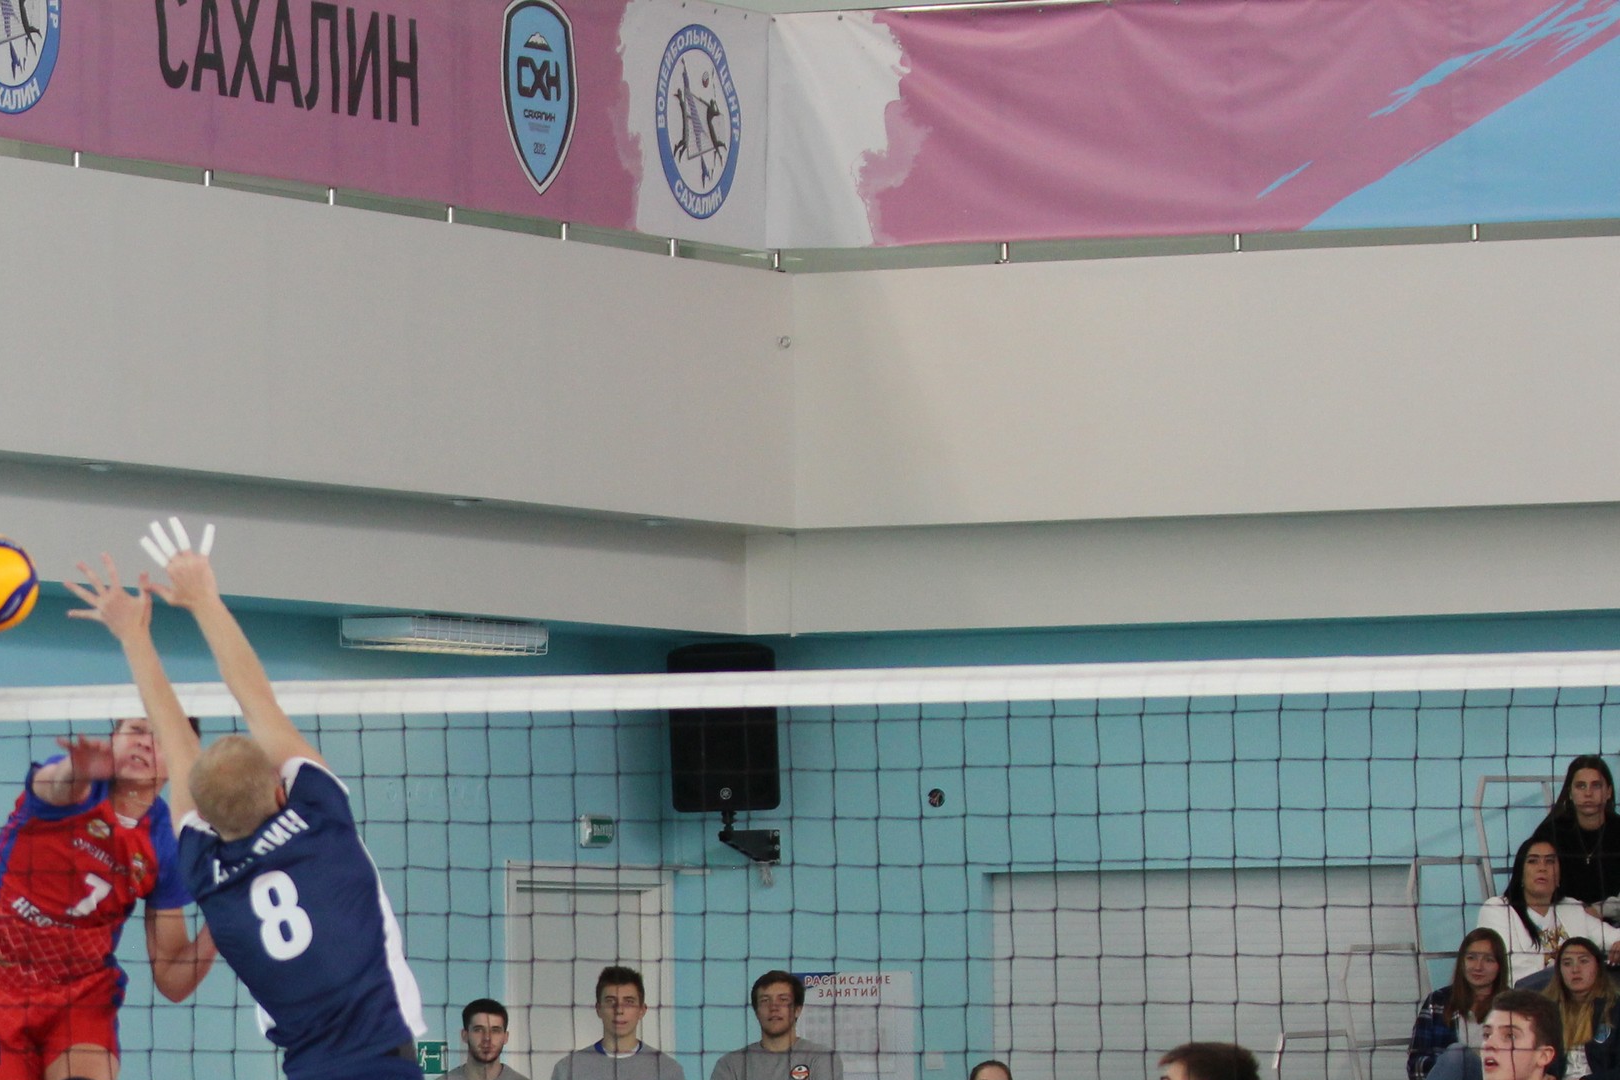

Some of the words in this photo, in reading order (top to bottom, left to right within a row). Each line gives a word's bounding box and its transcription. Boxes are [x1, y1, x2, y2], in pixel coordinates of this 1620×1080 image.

[155, 0, 420, 127] САХАЛИН
[657, 29, 723, 129] ВОЛЕЙБОЛЬНЫЙ
[674, 179, 723, 216] САХАЛИН
[249, 870, 314, 961] 8
[804, 974, 892, 986] РАСПИСАНИЕ
[818, 986, 879, 998] ЗАНЯТИЙ
